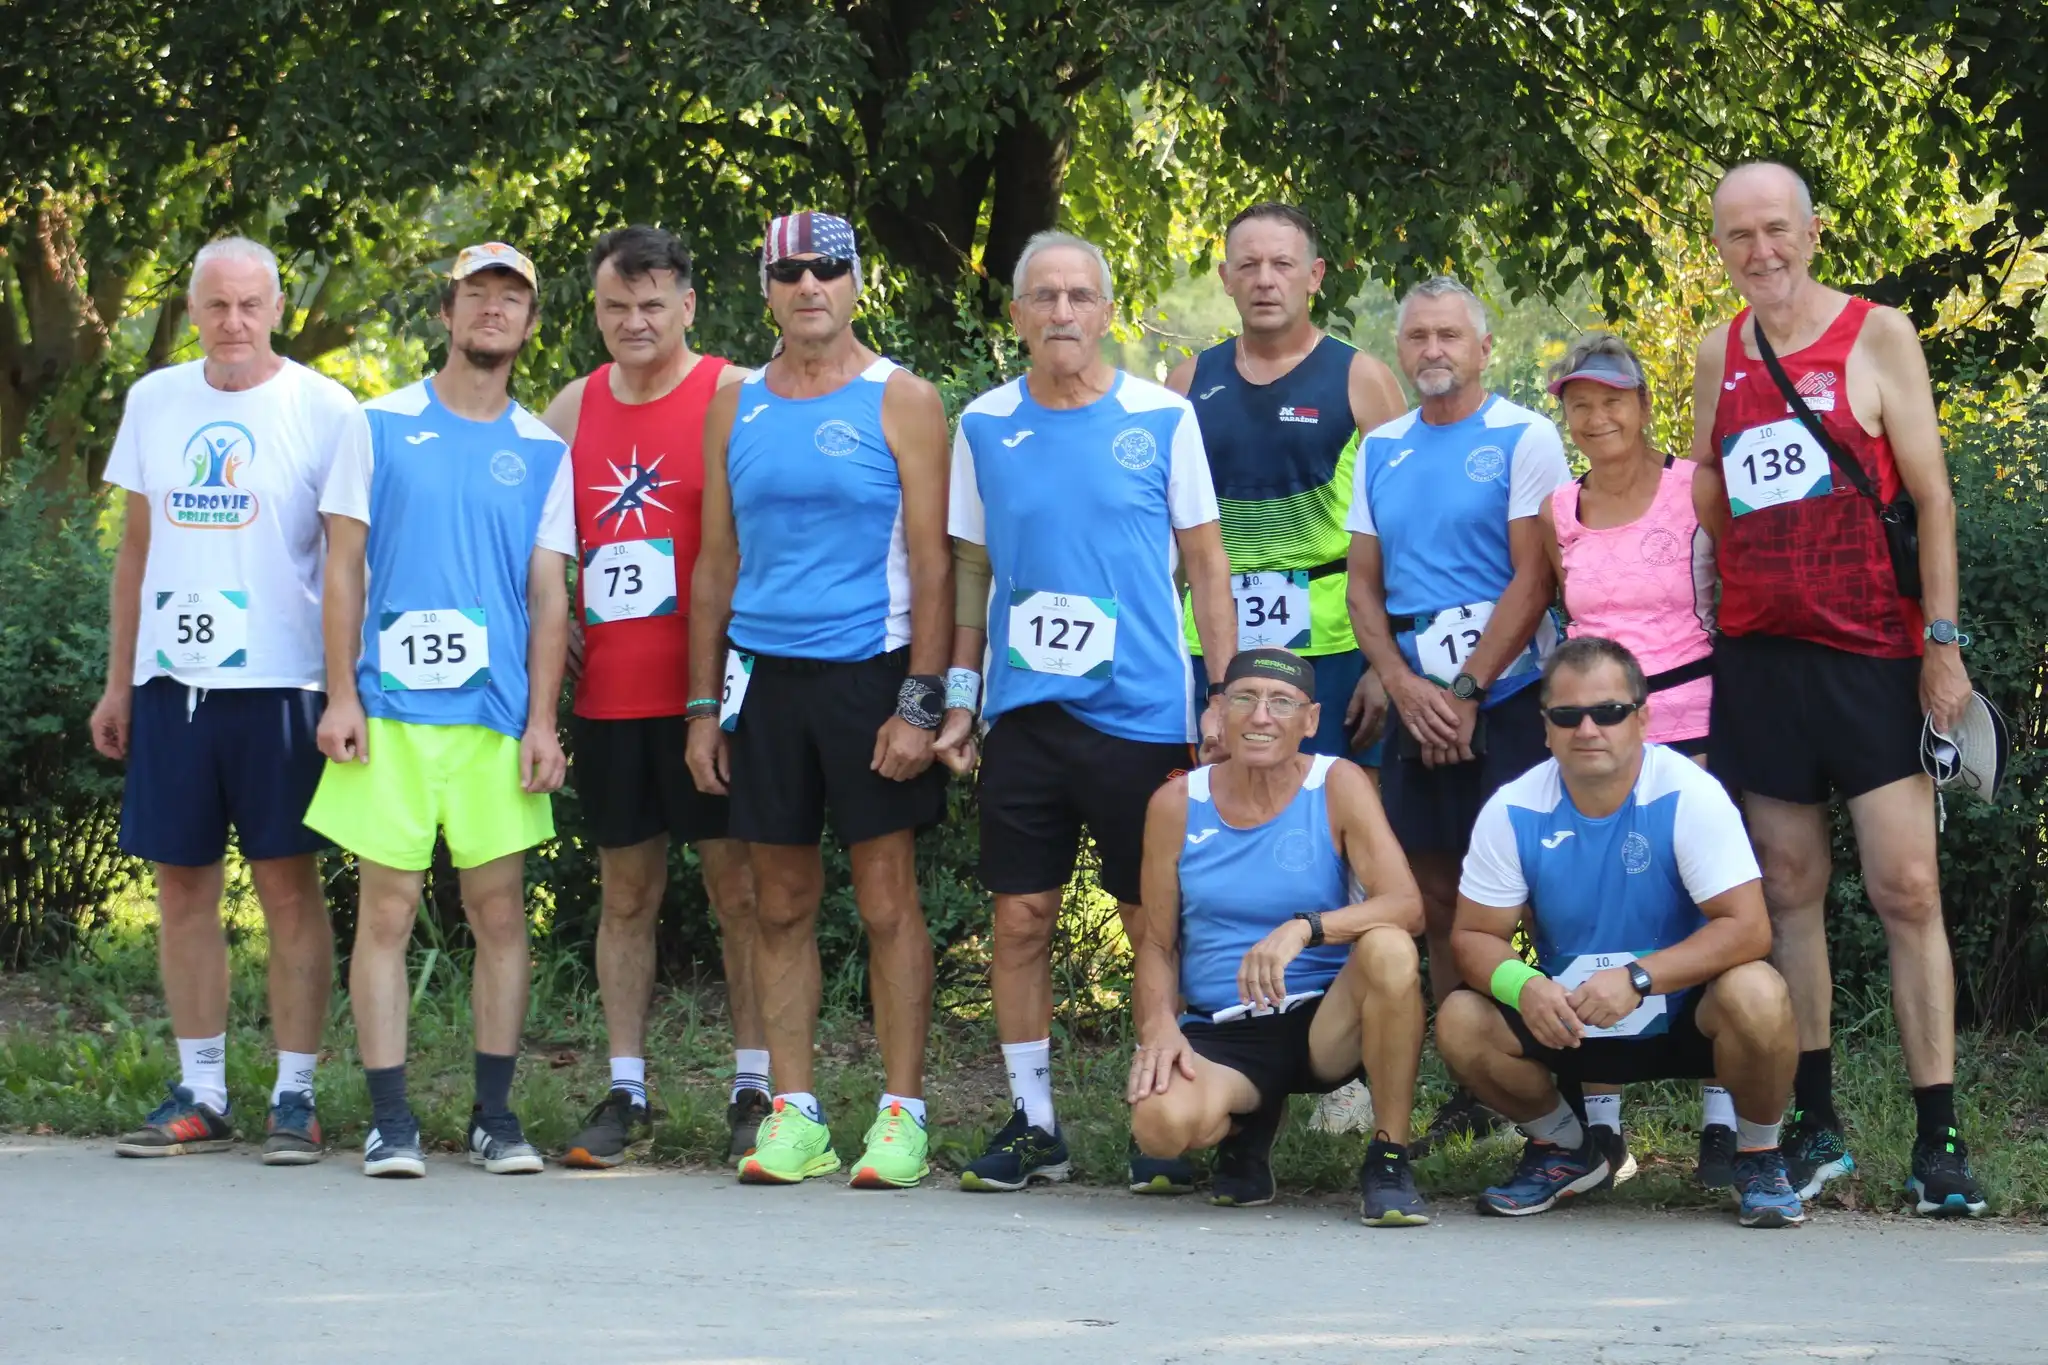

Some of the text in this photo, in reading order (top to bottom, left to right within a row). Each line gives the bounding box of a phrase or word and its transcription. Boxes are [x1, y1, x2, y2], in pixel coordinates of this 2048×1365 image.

[1759, 427, 1776, 439] 10.
[1741, 443, 1806, 485] 138
[172, 493, 250, 509] ZDROVJE
[178, 510, 240, 523] PRIJE SEGA
[614, 544, 628, 555] 10.
[604, 564, 643, 597] 73
[1053, 596, 1070, 607] 10.
[177, 613, 215, 644] 58
[1029, 615, 1095, 652] 127
[400, 633, 467, 665] 135
[1254, 659, 1296, 673] MERKUR
[1596, 957, 1614, 968] 10.
